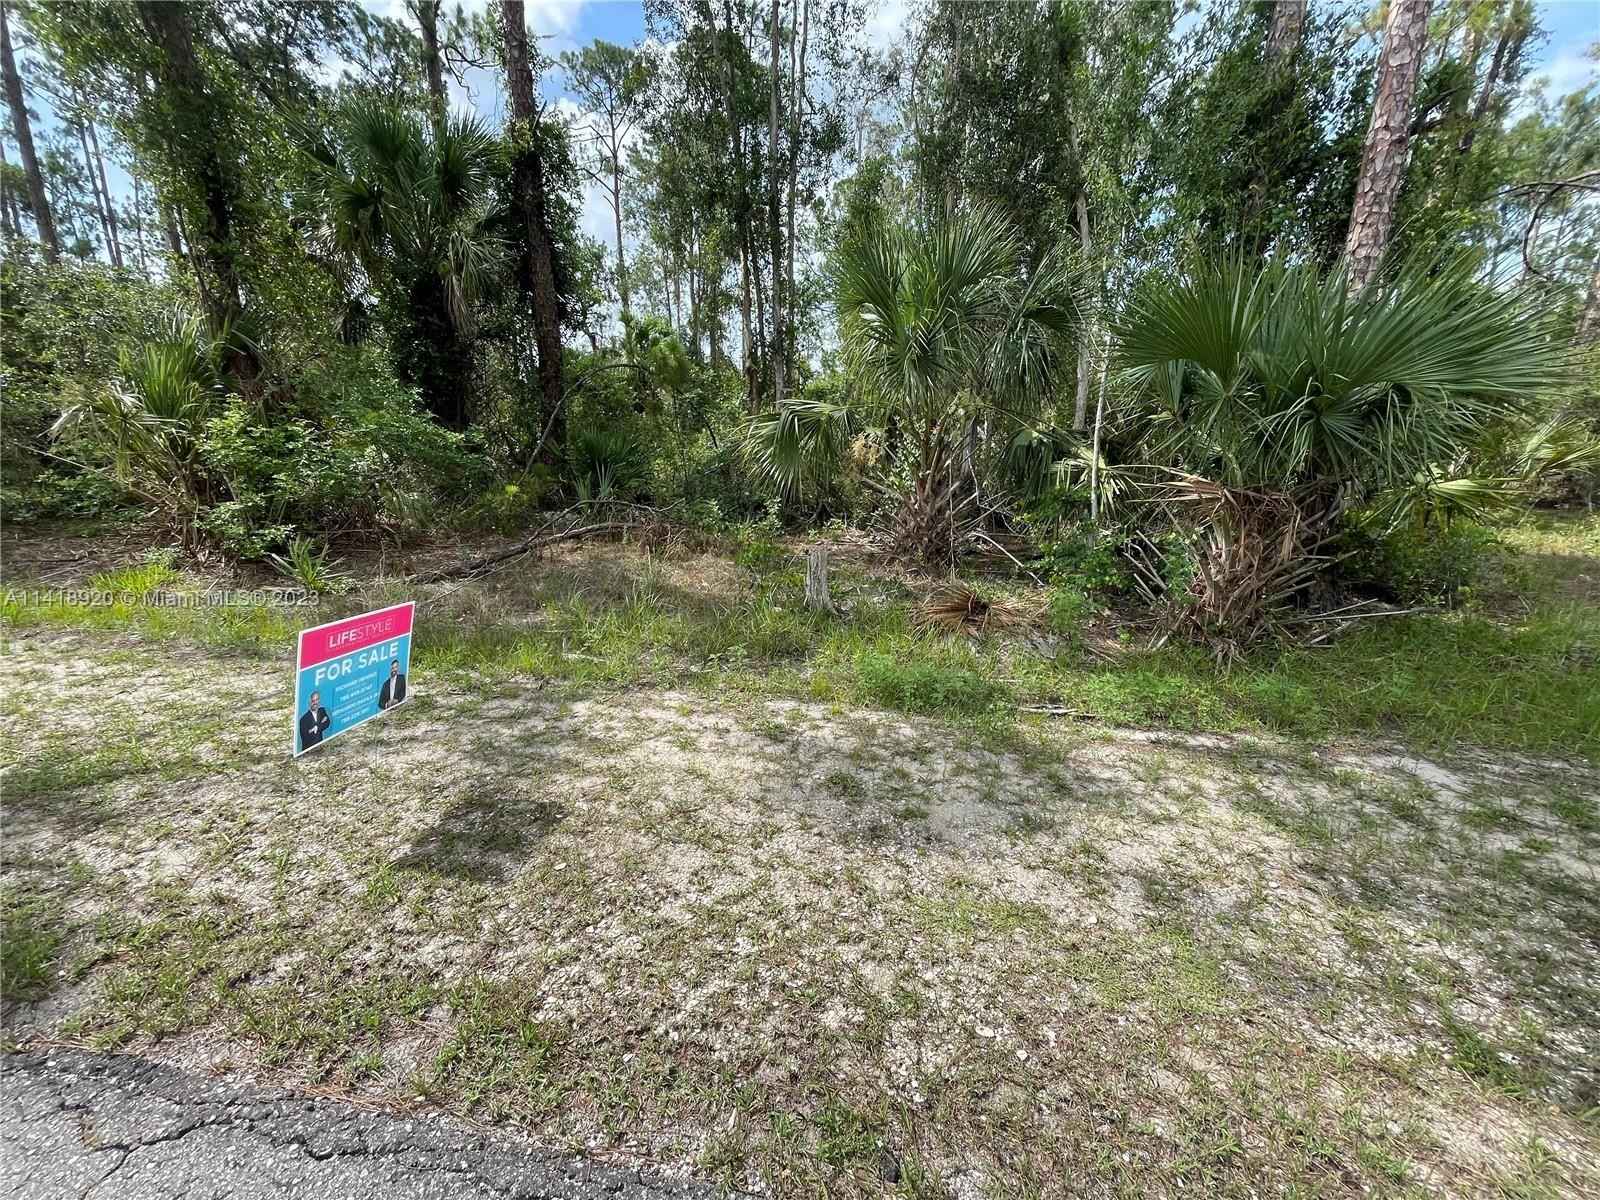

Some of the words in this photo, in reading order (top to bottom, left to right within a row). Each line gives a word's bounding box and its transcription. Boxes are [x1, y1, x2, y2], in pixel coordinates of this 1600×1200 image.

[329, 617, 393, 648] LIFESTYLE
[315, 657, 353, 686] FOR
[358, 642, 399, 668] SALE
